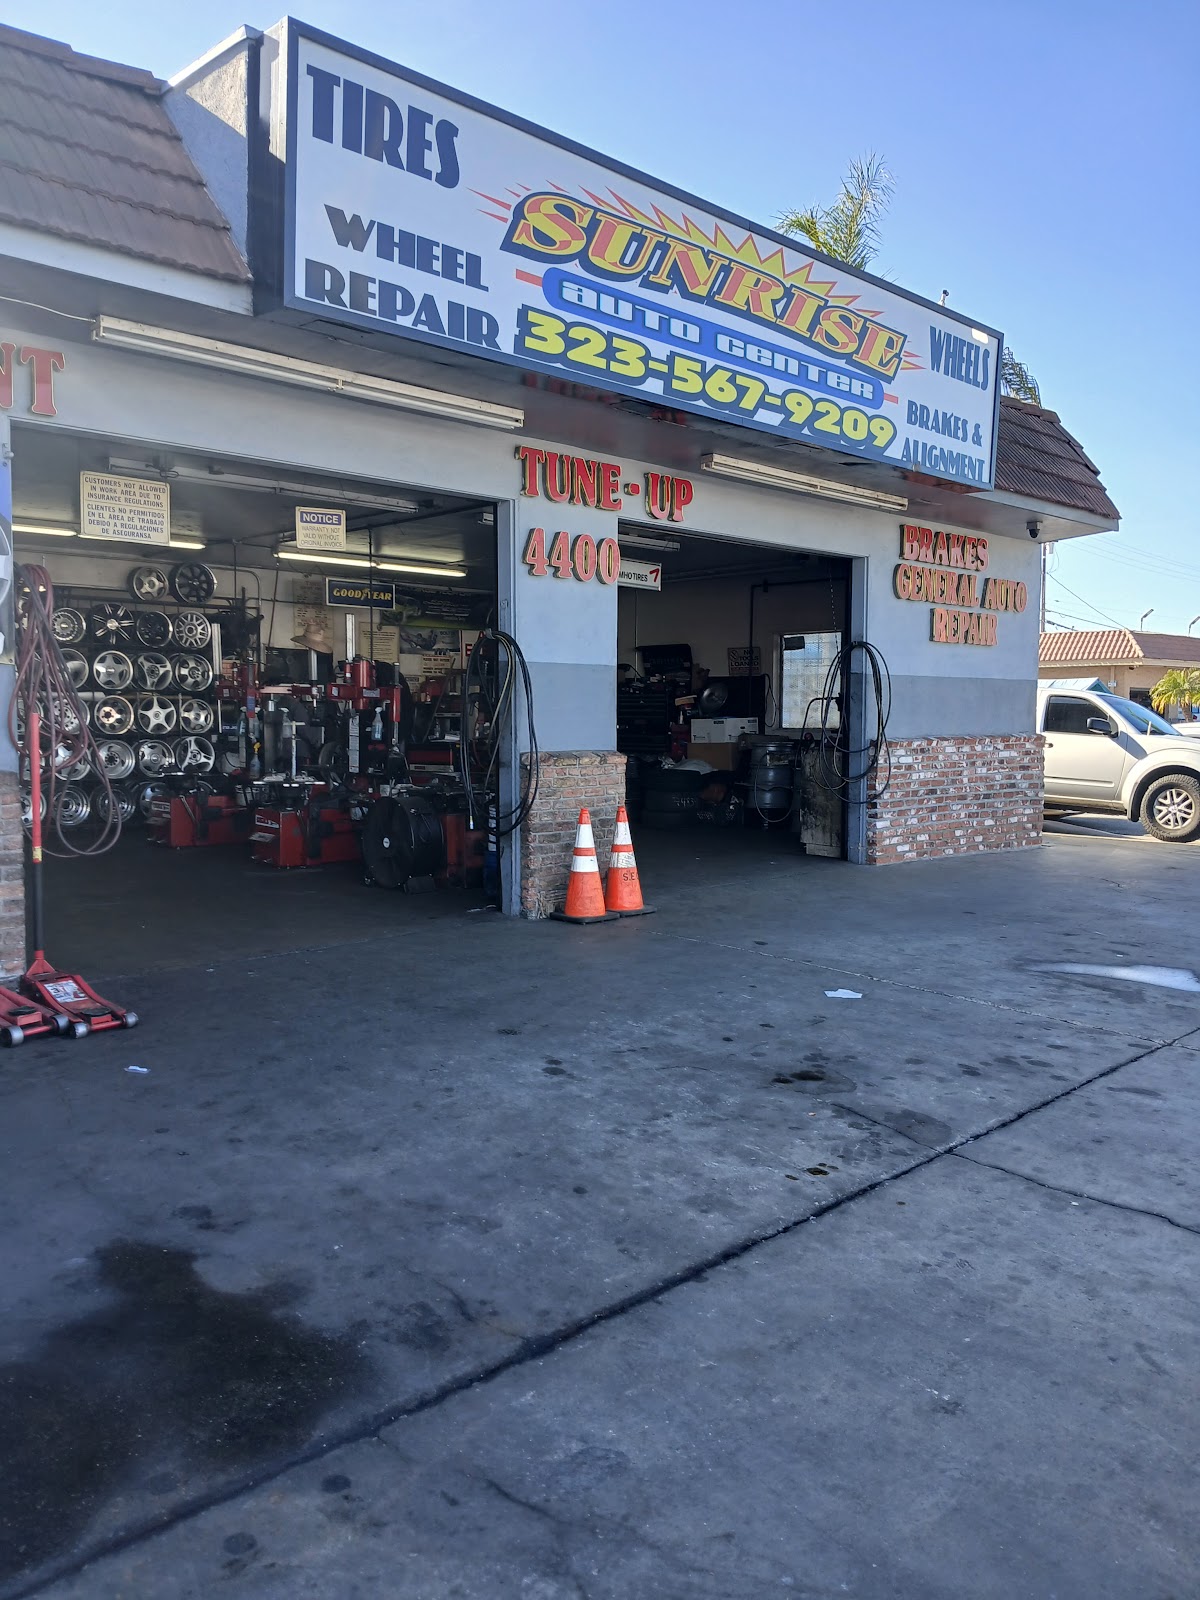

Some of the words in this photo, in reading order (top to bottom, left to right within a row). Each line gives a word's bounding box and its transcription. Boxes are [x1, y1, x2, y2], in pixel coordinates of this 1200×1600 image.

[306, 63, 460, 189] TIRES
[323, 203, 489, 292] WHEEL
[304, 258, 502, 350] REPAIR
[501, 192, 907, 382] SUNRISE
[519, 308, 896, 450] 323-567-9209
[929, 325, 990, 391] WHEELS
[906, 399, 968, 443] BRAKES
[972, 423, 983, 447] &
[901, 437, 985, 483] ALIGNMENT
[84, 476, 122, 488] CUSTOMERS
[123, 481, 136, 489] NOT
[138, 484, 166, 494] ALLOWED
[87, 492, 122, 503] INSURANCE
[124, 497, 164, 508] REGULATIONS
[99, 486, 118, 495] WORK
[120, 489, 137, 497] AREA
[139, 491, 151, 499] DUE
[86, 503, 116, 513] CLIENTES
[118, 506, 127, 514] NO
[129, 508, 165, 519] PERMITIDOS
[87, 510, 96, 518] EN
[108, 513, 125, 521] AREA
[127, 515, 135, 523] DE
[138, 517, 164, 526] TRABAJO
[88, 519, 111, 527] DEBIDO
[120, 522, 164, 533] REGULACIONES
[302, 512, 339, 524] NOTICE
[522, 527, 621, 585] 4400
[899, 524, 989, 571] BRAKES
[619, 571, 632, 580] MHO
[892, 563, 979, 607] GENERAL
[980, 577, 1028, 613] AUTO
[929, 608, 998, 646] REPAIR
